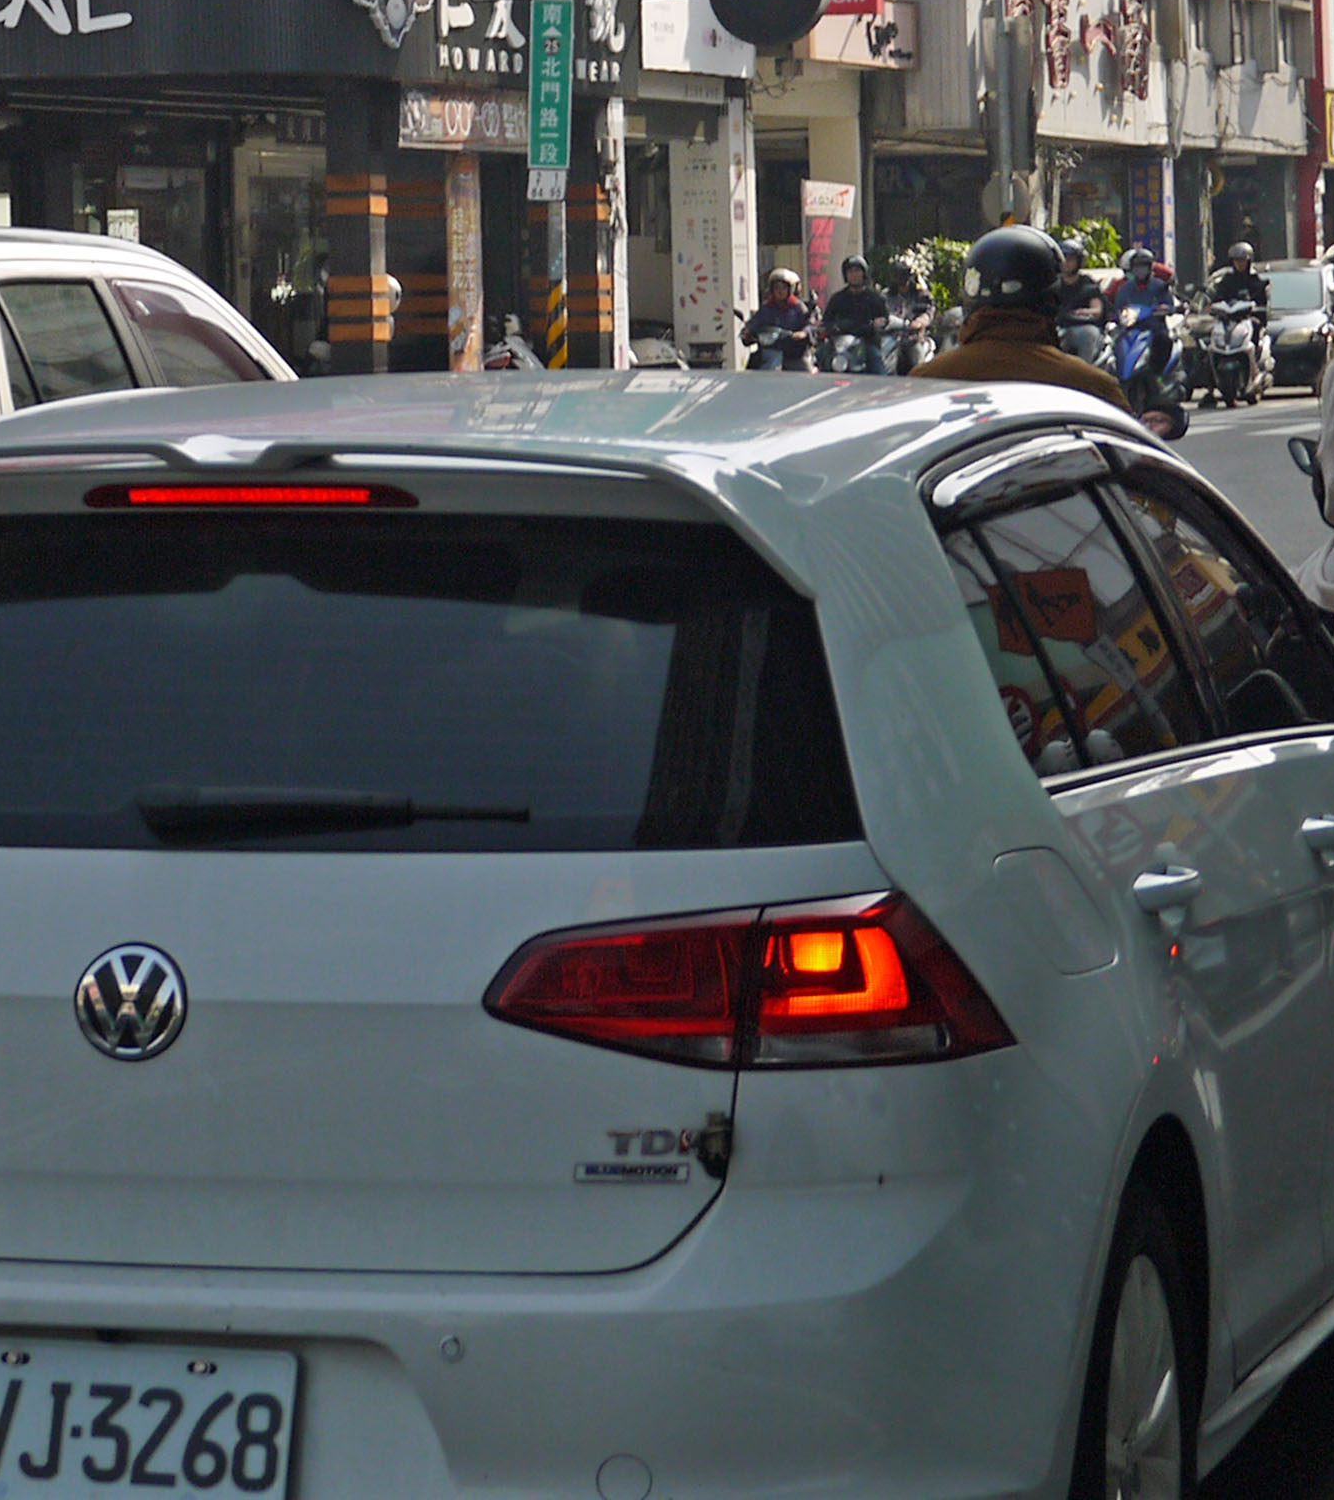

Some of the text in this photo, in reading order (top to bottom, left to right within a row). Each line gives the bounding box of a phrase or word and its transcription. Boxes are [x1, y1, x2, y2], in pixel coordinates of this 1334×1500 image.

[438, 43, 621, 83] HOWARD WEAR
[538, 57, 562, 164] 北門路一段
[607, 1128, 691, 1157] TDI
